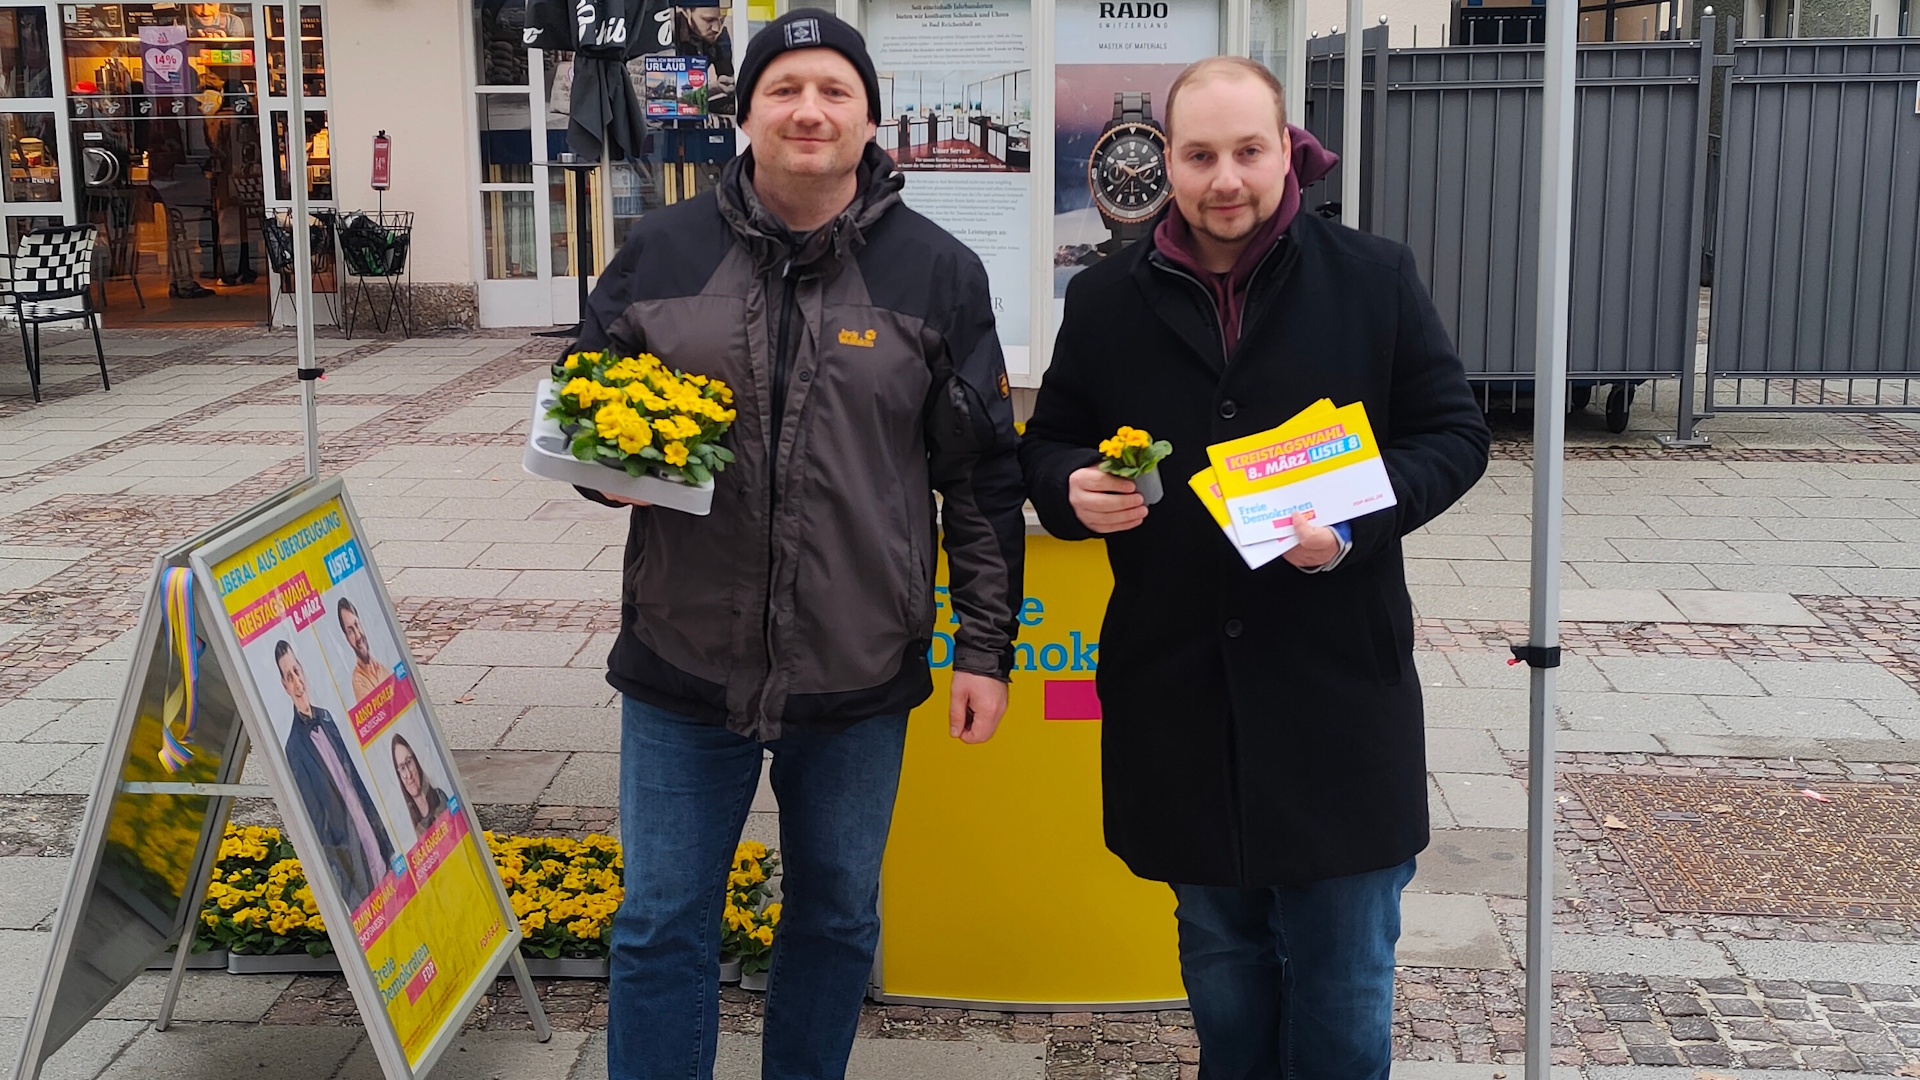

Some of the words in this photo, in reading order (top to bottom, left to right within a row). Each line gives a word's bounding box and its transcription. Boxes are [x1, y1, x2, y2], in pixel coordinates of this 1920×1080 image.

[1099, 2, 1168, 19] RADO
[1134, 42, 1167, 50] MATERIALS
[154, 54, 177, 65] 14%
[645, 62, 686, 71] URLAUB
[1229, 426, 1344, 468] KREISTAGSWAHL
[1248, 467, 1262, 480] 8.
[1265, 452, 1307, 476] MÄRZ
[1311, 440, 1345, 460] LISTE
[1347, 436, 1358, 449] 8
[1238, 502, 1267, 516] Freie
[1242, 501, 1313, 525] Demokraten
[256, 548, 278, 574] AUS
[274, 510, 341, 561] ÜBERZEUGUNG
[328, 552, 350, 578] LISTE
[348, 547, 357, 566] 8
[233, 578, 310, 639] KREISTAGSWAHL
[300, 596, 322, 620] MÄRZ
[352, 906, 373, 934] RMIN
[381, 943, 430, 1006] Demokraten
[421, 961, 436, 983] FDP
